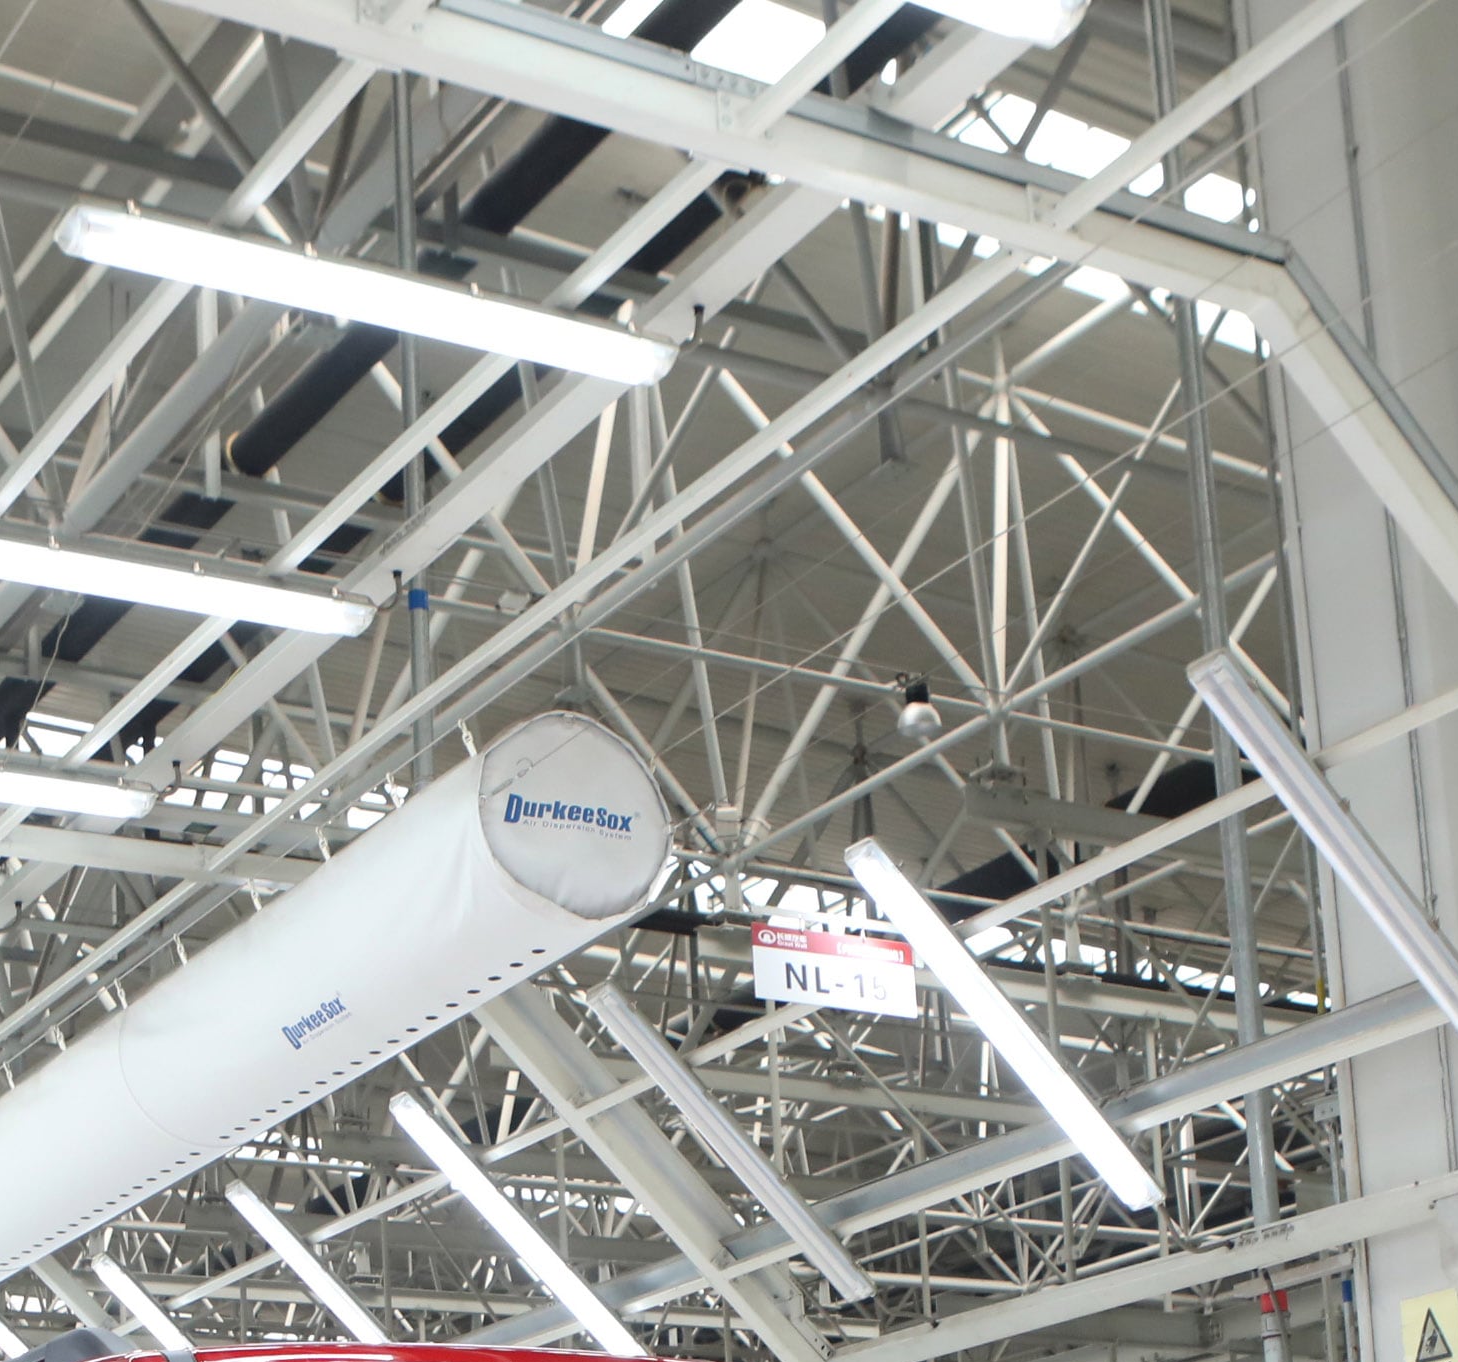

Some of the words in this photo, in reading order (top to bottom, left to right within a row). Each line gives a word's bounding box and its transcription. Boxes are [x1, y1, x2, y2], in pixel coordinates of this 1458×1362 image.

[504, 793, 634, 832] DurkeeSox
[542, 820, 596, 833] Dispersion
[599, 829, 632, 841] System
[282, 997, 346, 1050] DurkeeSox
